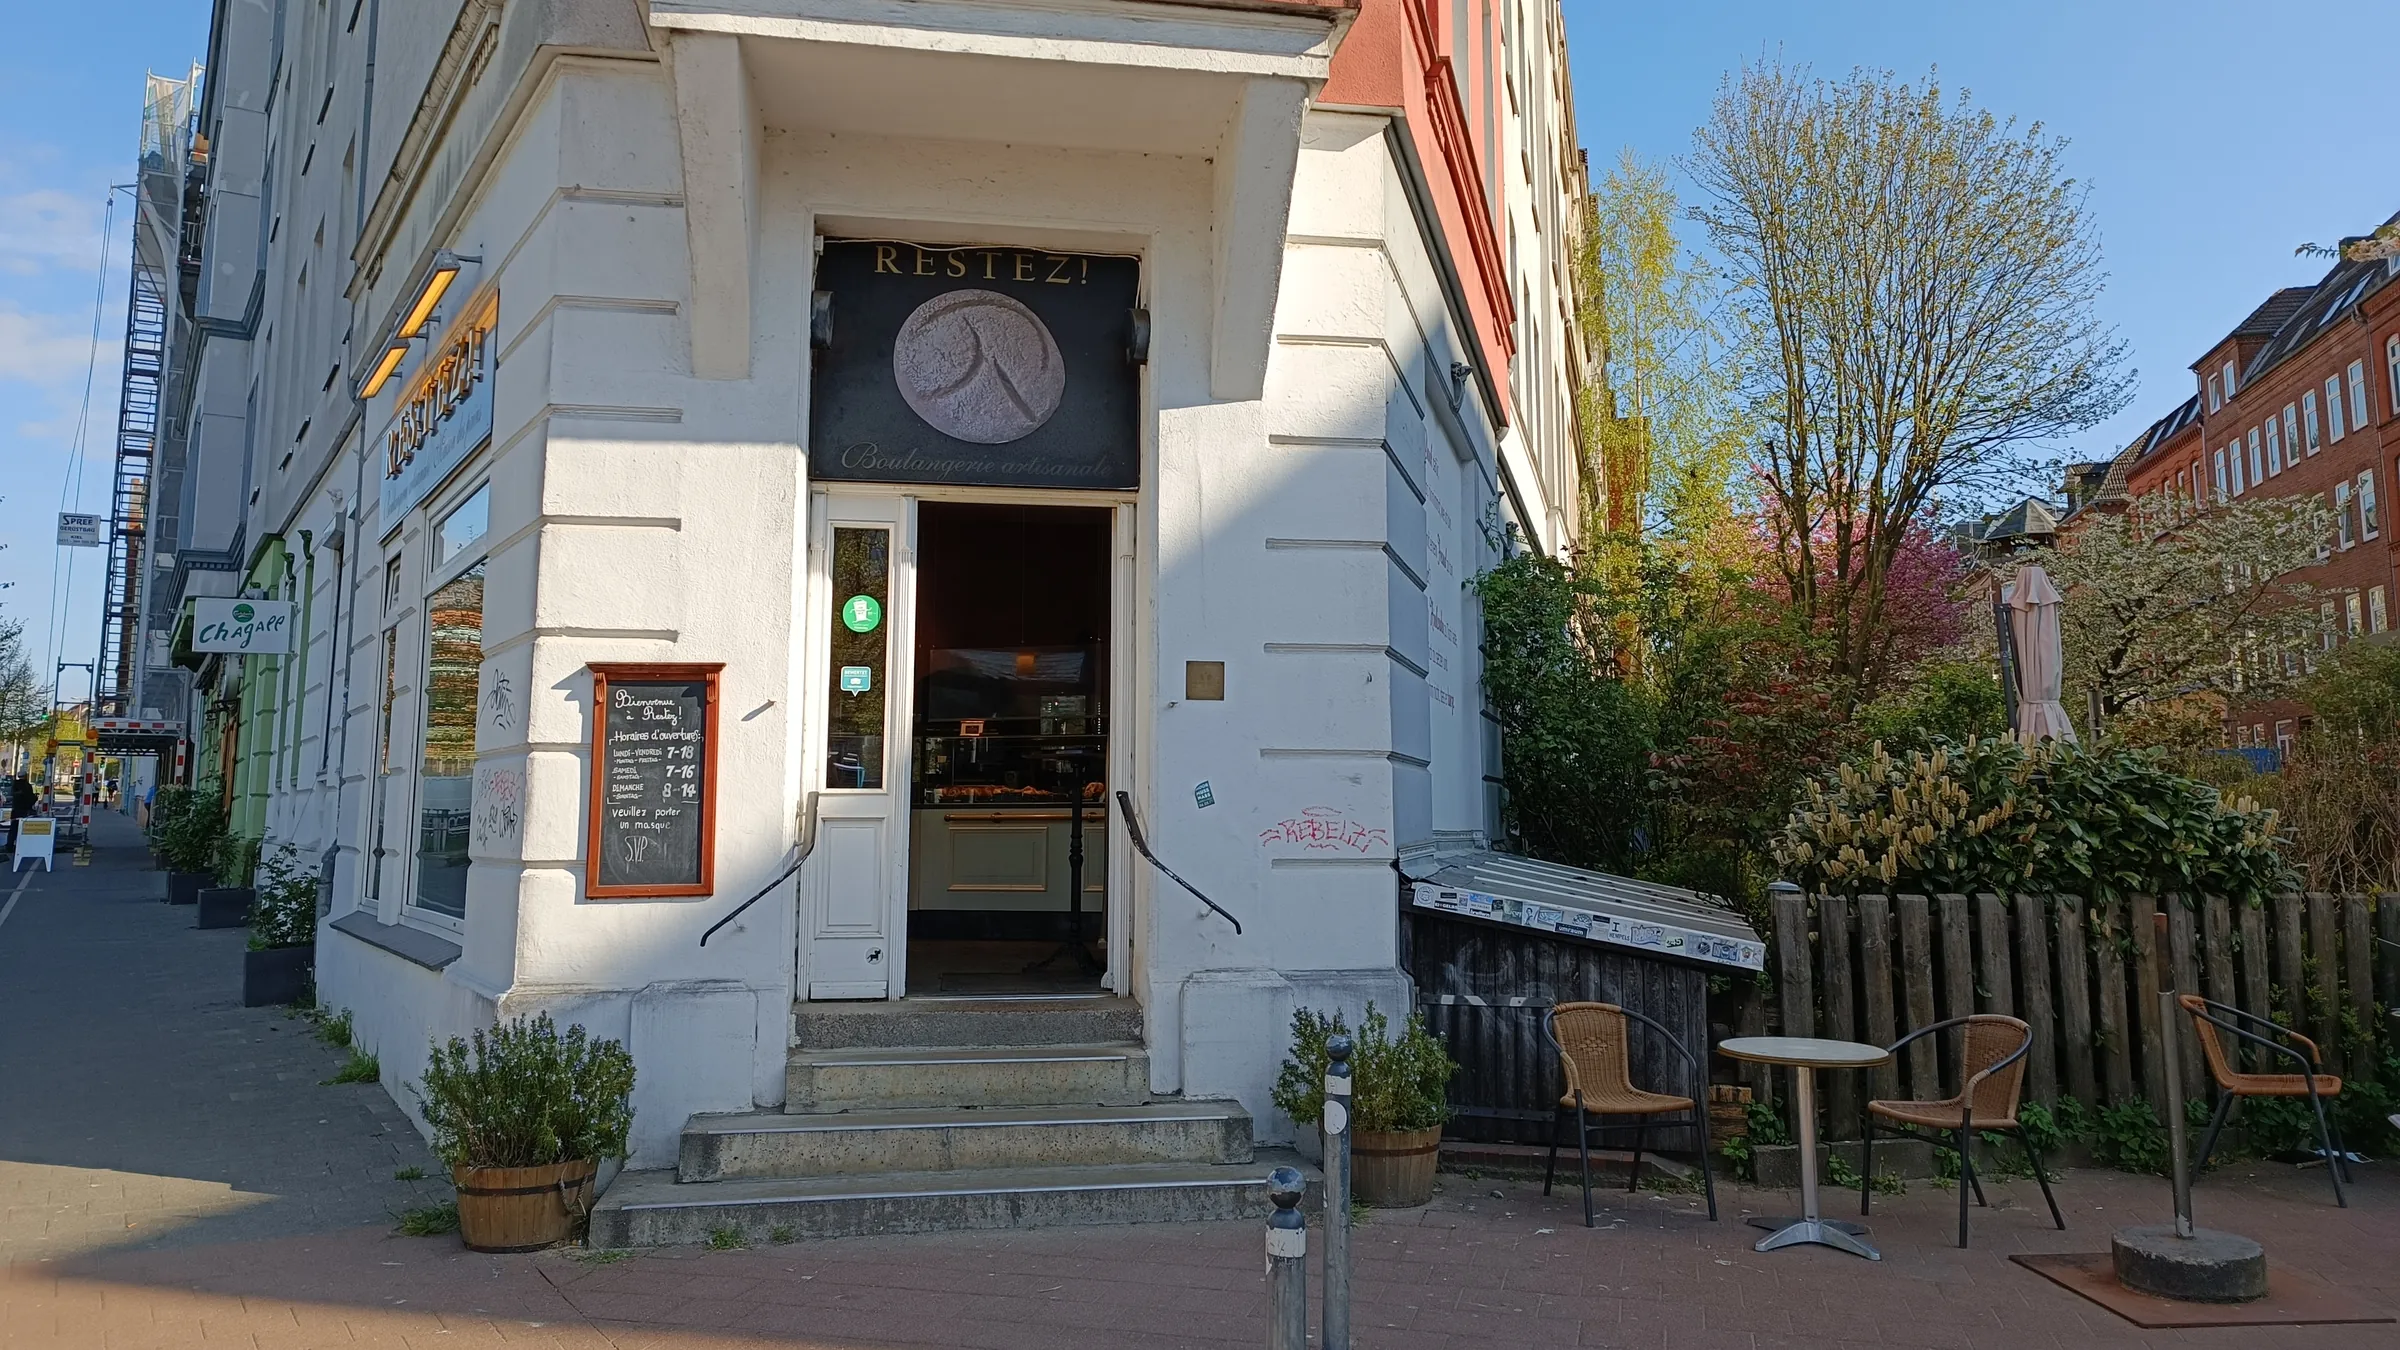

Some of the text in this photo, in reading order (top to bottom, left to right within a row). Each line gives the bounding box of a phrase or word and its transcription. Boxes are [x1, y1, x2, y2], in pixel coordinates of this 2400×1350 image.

[874, 245, 1088, 285] RESTEZ!
[385, 327, 486, 480] RESTEZ!
[841, 441, 1115, 480] Boulangerie artisanale
[62, 514, 94, 526] SPREE
[199, 614, 285, 649] Chagall
[615, 688, 676, 709] Bienvenue
[626, 705, 683, 726] à Restez!
[614, 730, 649, 742] Horaires
[667, 744, 695, 760] 7-18
[665, 764, 696, 779] 7-16
[611, 805, 681, 820] veuillez porter
[619, 821, 671, 834] un masque
